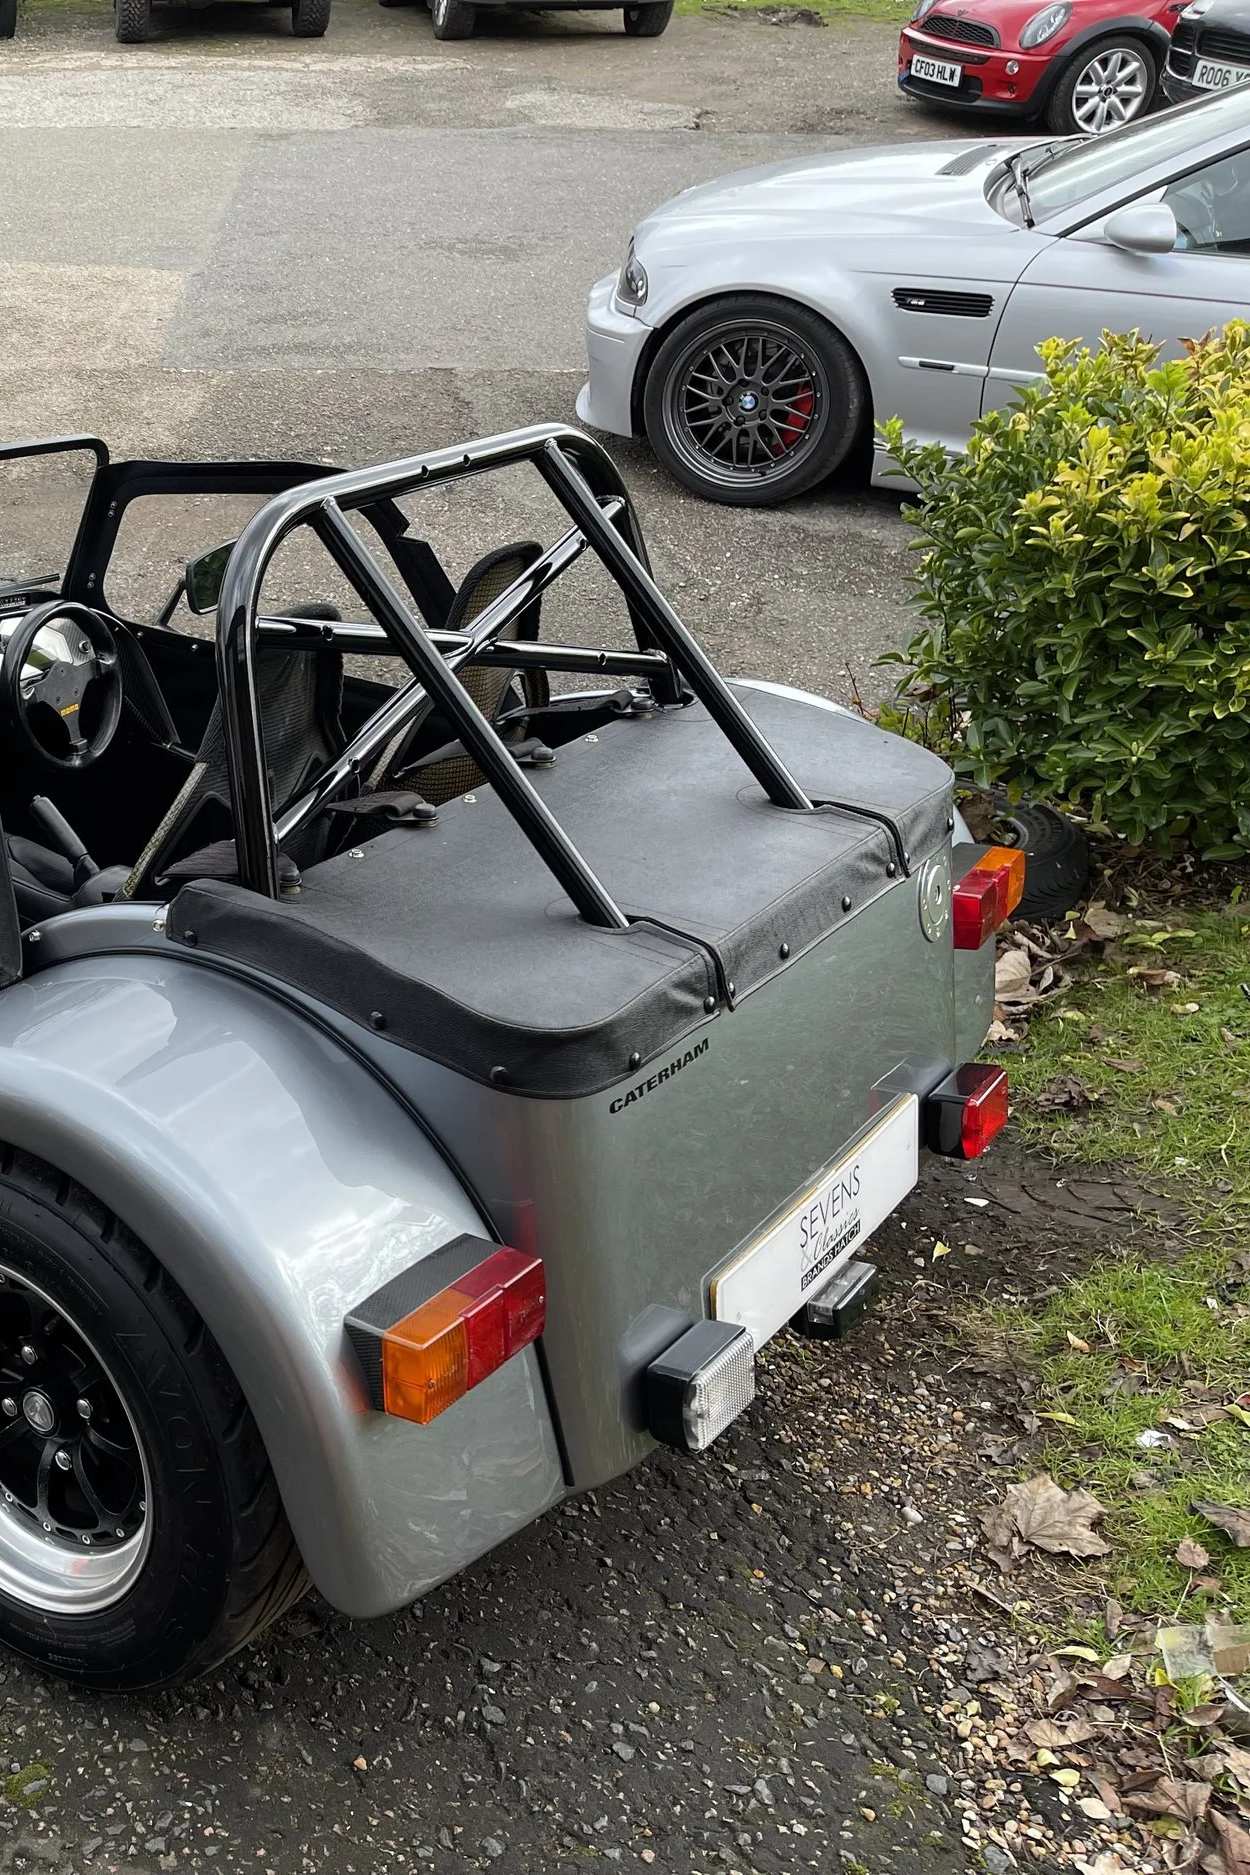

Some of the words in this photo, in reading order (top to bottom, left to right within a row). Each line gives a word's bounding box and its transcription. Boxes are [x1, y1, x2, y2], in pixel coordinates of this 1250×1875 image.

[915, 58, 936, 78] CF03
[609, 1037, 710, 1115] CATERHAM
[800, 1164, 861, 1249] SEVENS
[813, 1207, 861, 1261] Classics
[802, 1249, 834, 1289] BRANDS
[834, 1221, 860, 1257] HATCH
